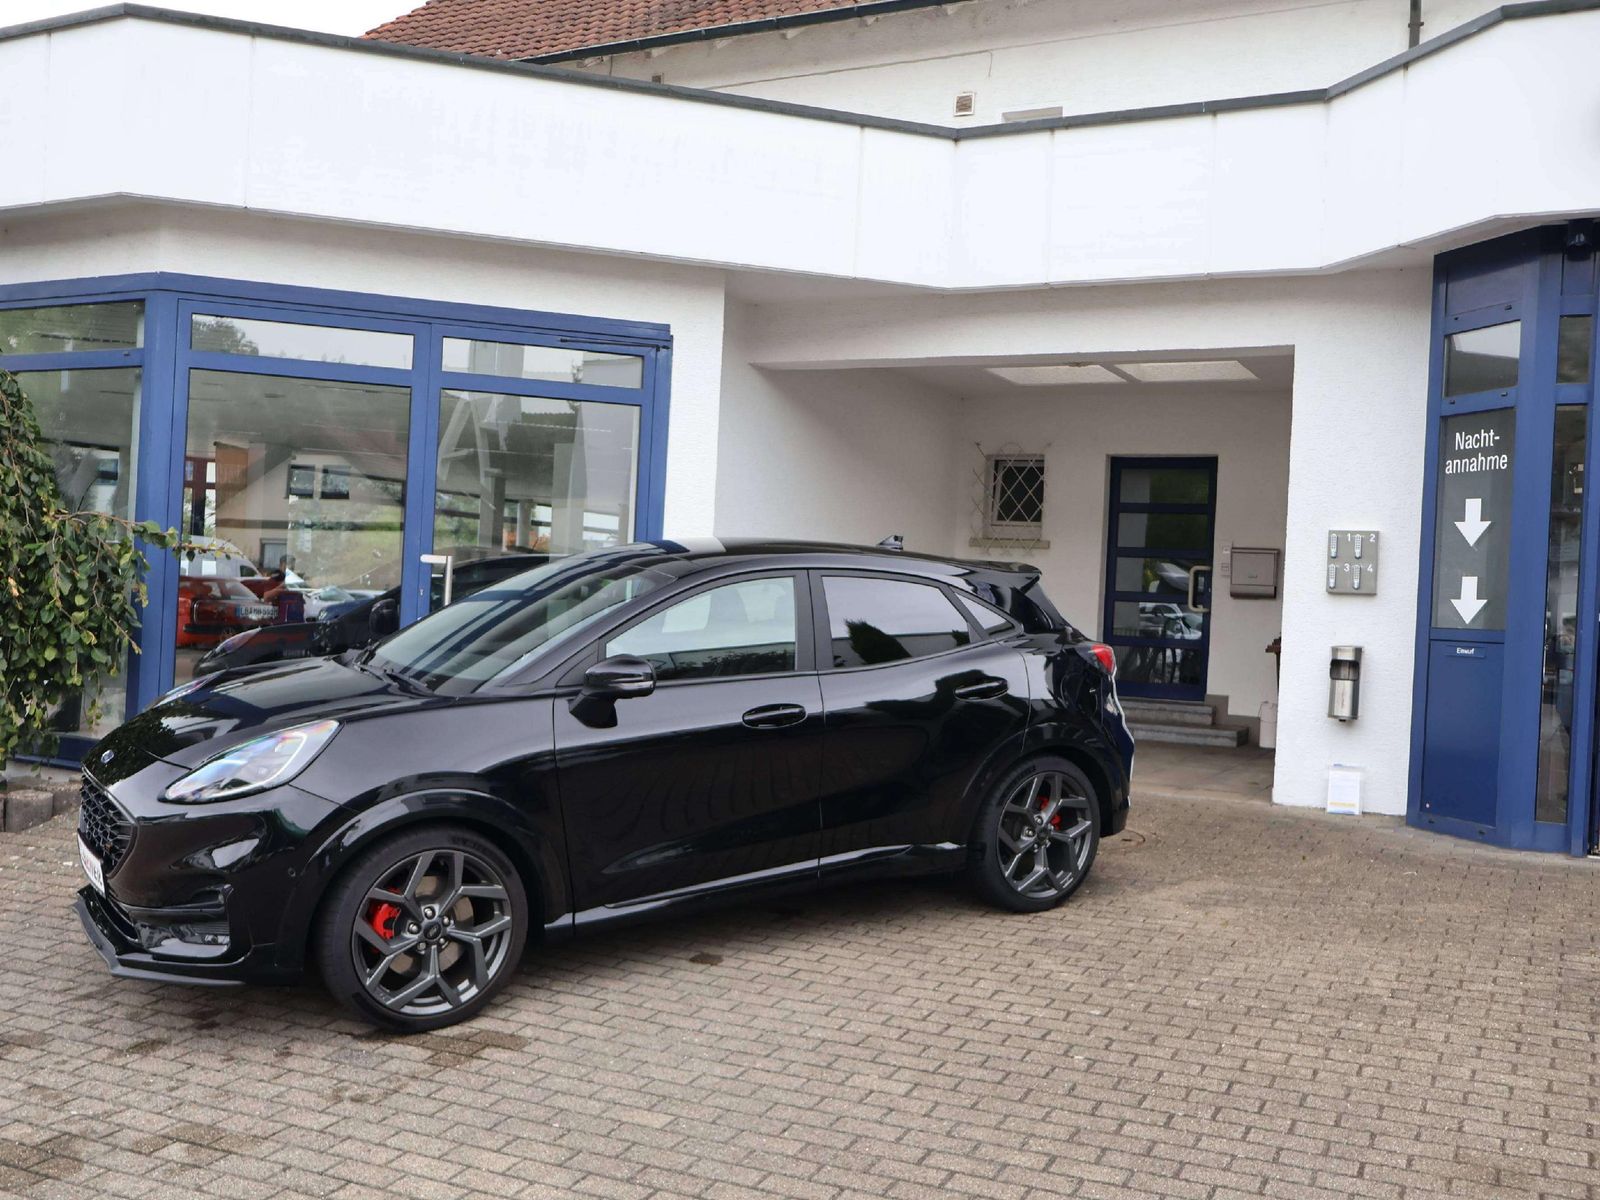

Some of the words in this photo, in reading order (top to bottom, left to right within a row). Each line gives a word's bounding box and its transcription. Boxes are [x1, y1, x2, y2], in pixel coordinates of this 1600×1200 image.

[1455, 429, 1500, 450] Nacht-
[1445, 452, 1508, 474] annahme
[1370, 534, 1376, 542] 2
[1344, 563, 1350, 572] 3
[1367, 564, 1373, 572] 4
